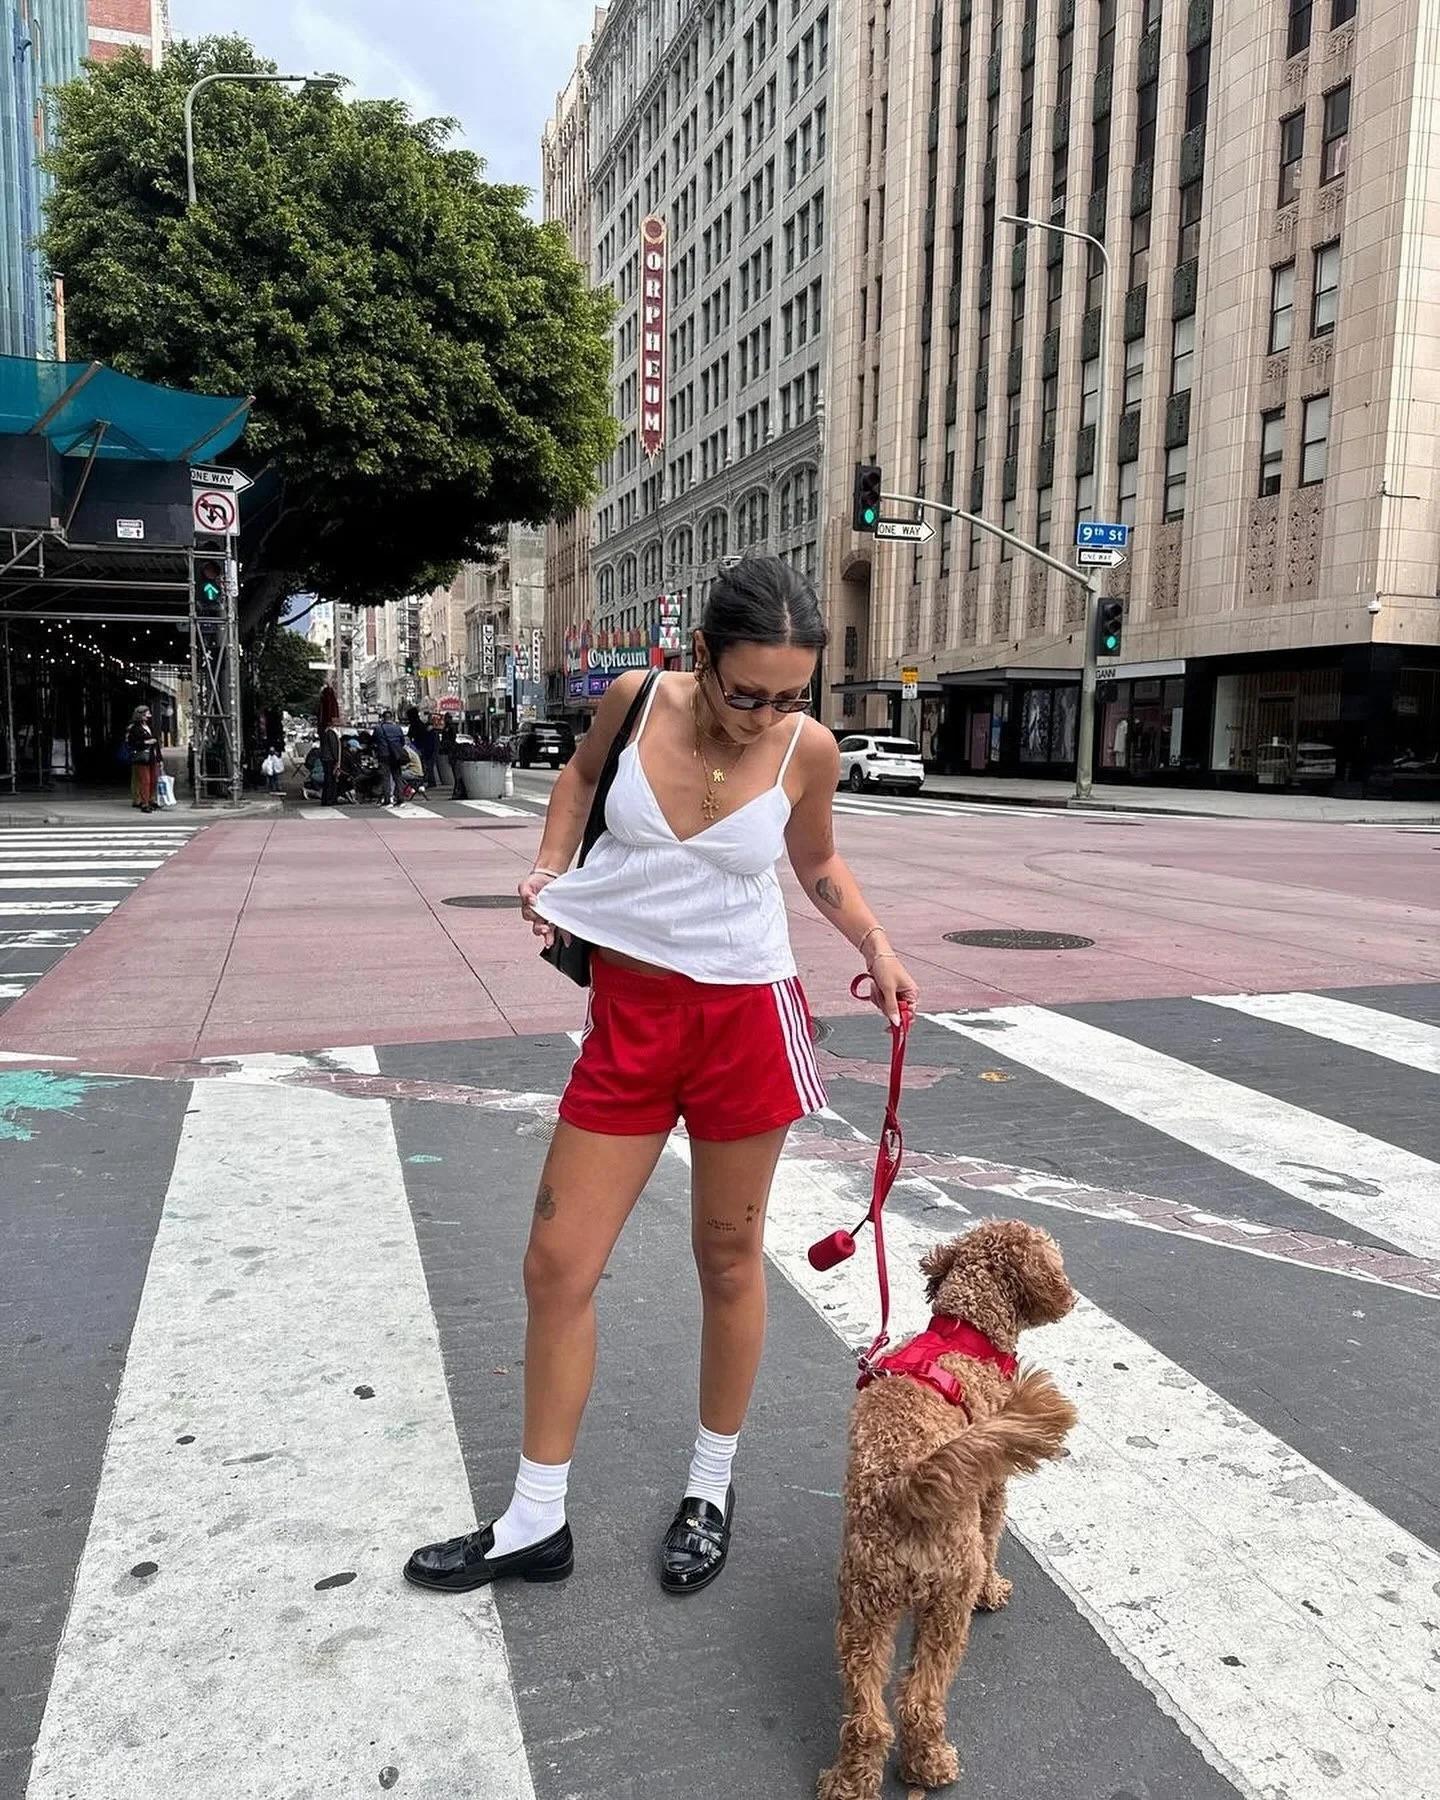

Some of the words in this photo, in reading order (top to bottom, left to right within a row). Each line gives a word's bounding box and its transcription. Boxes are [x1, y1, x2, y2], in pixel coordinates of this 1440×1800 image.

[645, 252, 661, 431] ORPHEUM
[190, 470, 209, 481] ONE
[212, 474, 232, 484] WAY
[879, 524, 896, 535] ONE
[902, 526, 920, 536] WAY
[1083, 527, 1104, 541] 9th
[1108, 530, 1123, 541] St
[588, 648, 647, 673] Orpheum
